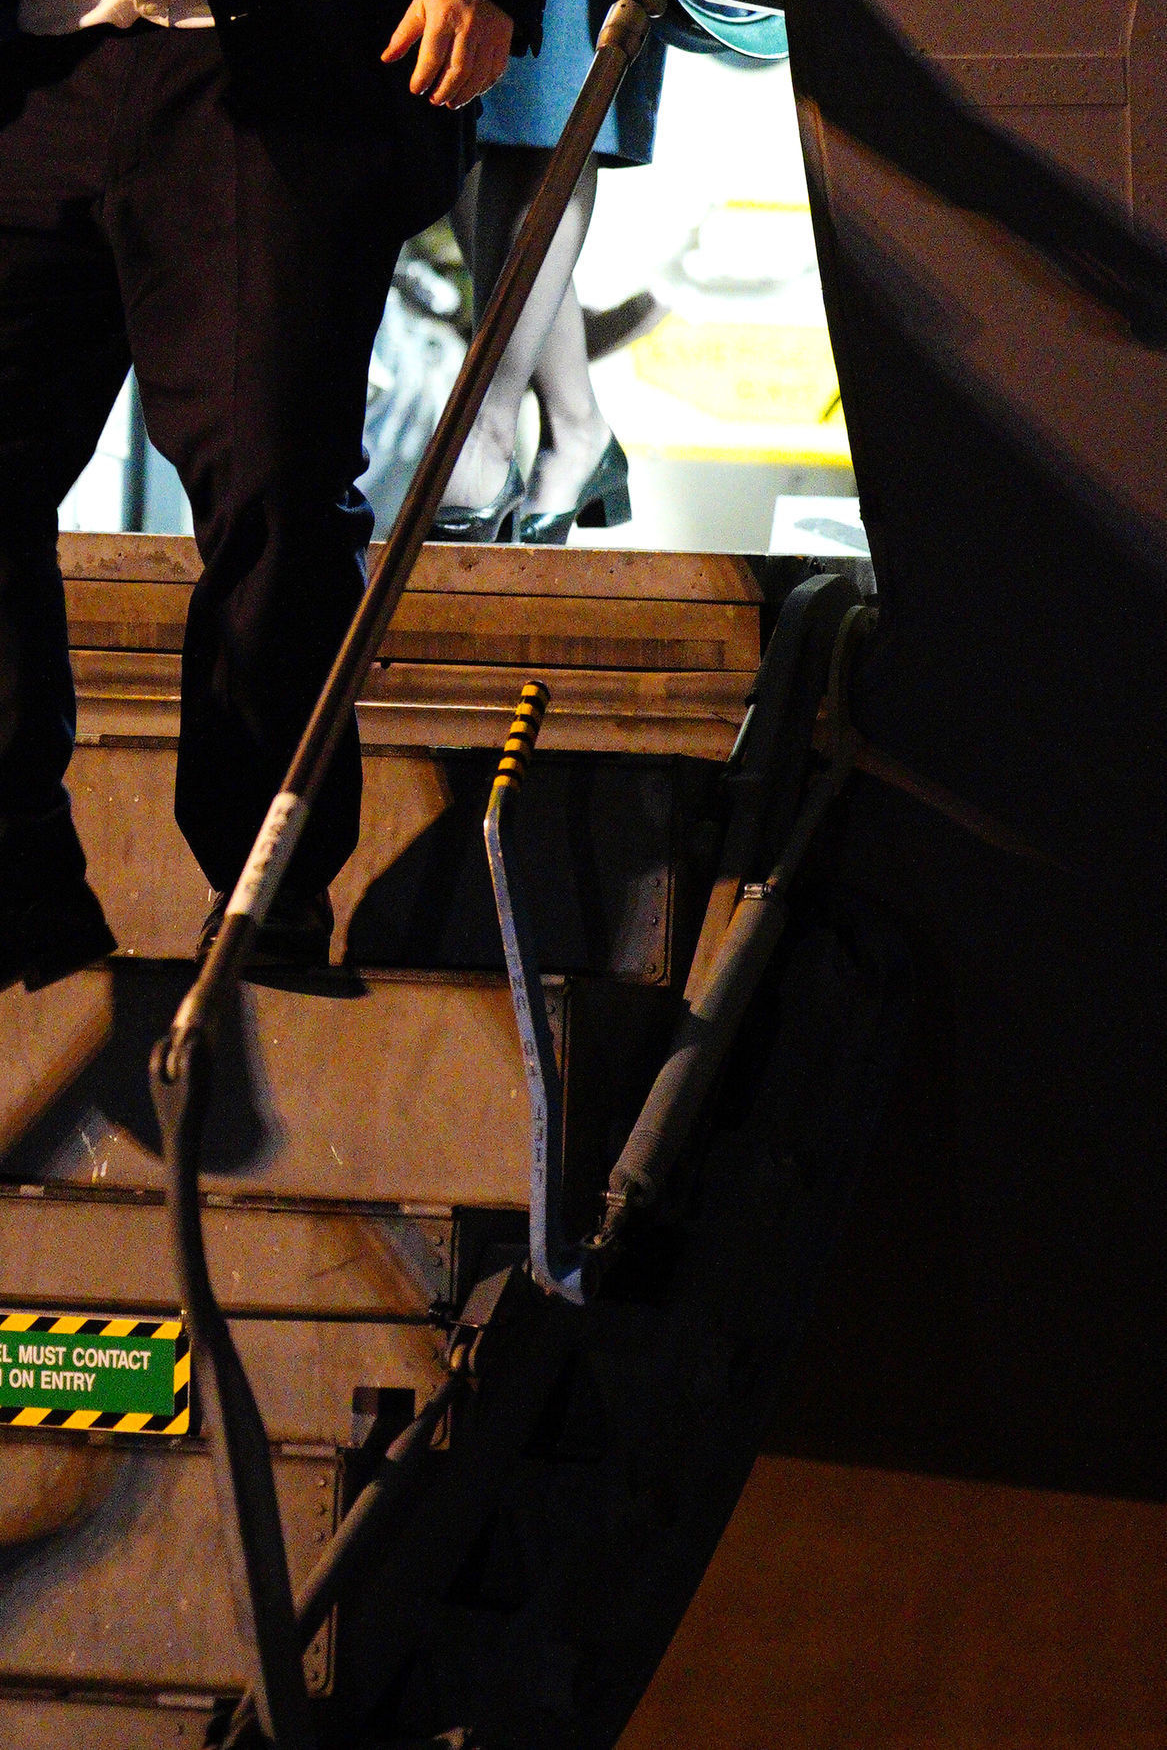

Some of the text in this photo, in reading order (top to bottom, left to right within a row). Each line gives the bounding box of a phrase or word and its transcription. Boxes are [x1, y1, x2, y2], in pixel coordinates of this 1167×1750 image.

[18, 1344, 67, 1366] MUST
[72, 1347, 152, 1371] CONTACT
[9, 1368, 34, 1389] ON
[40, 1370, 97, 1392] ENTRY
